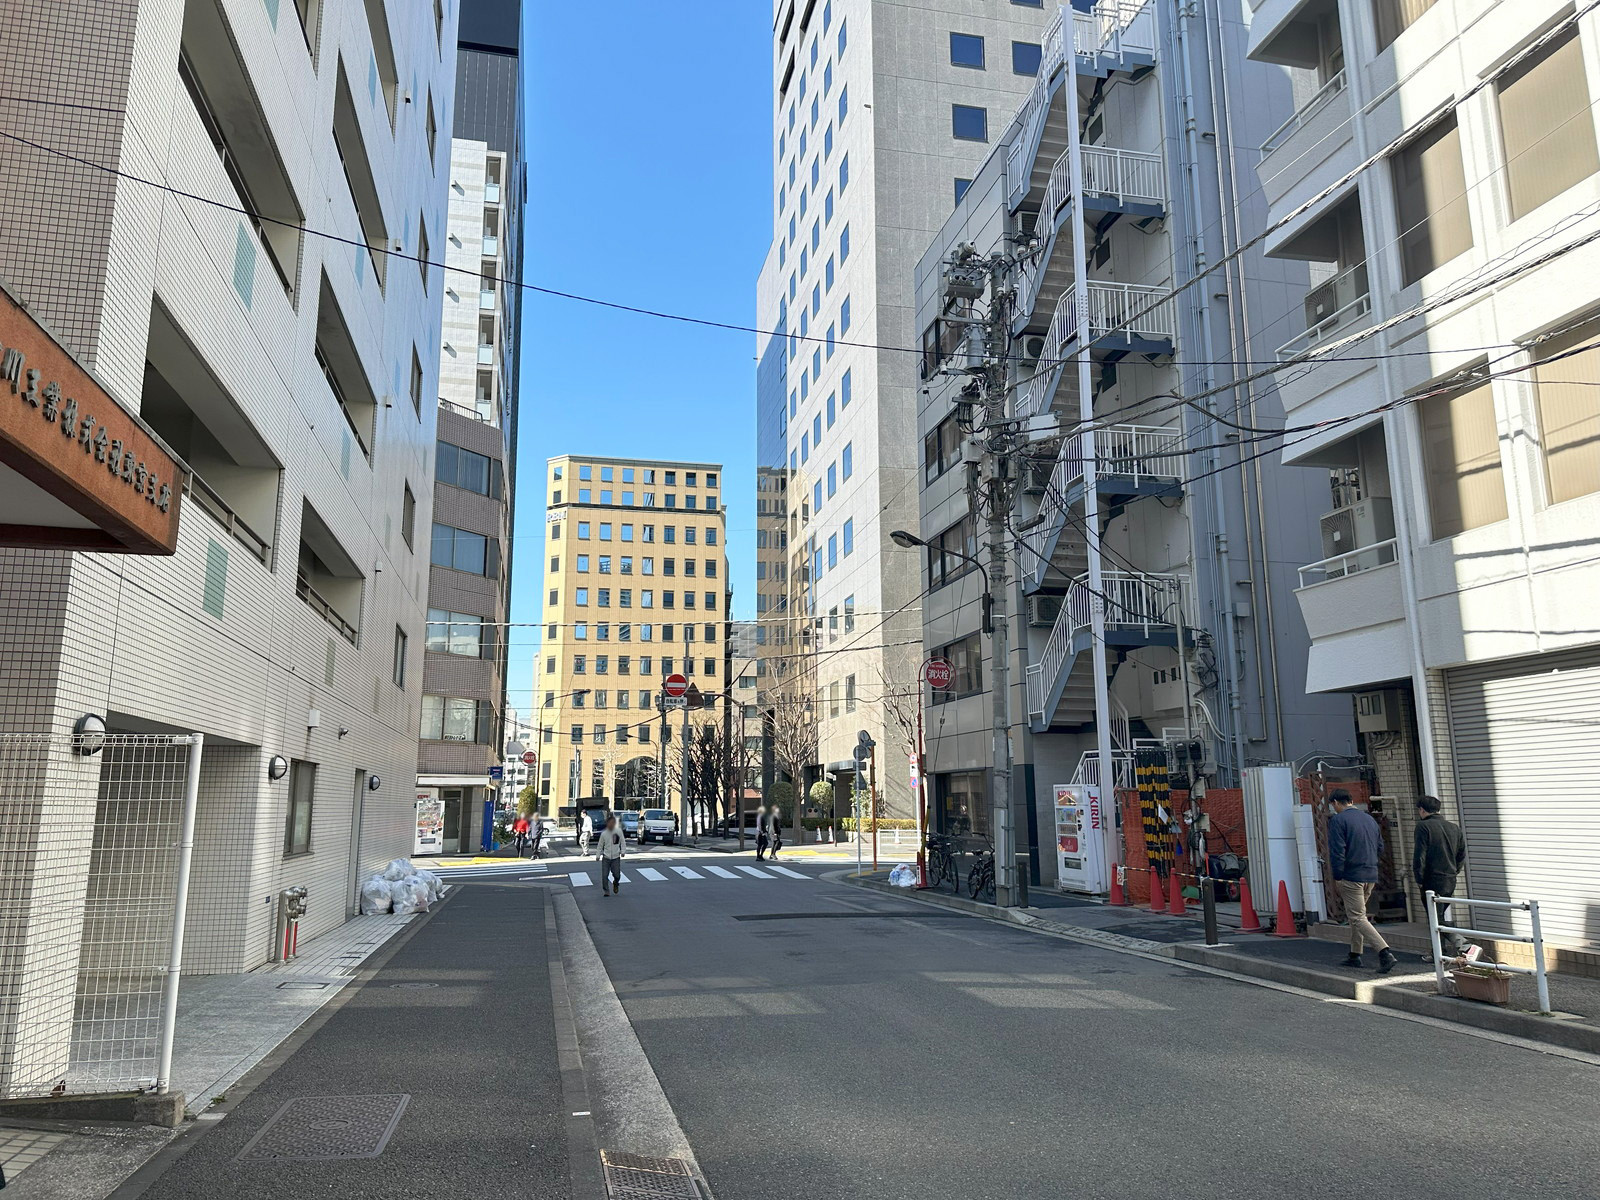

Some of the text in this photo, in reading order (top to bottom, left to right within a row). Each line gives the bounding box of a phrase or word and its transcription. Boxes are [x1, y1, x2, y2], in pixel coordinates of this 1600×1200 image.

[0, 343, 171, 514] 川工業株式会社東京支店
[928, 669, 949, 680] 消火栓
[1090, 796, 1100, 829] KIRIN
